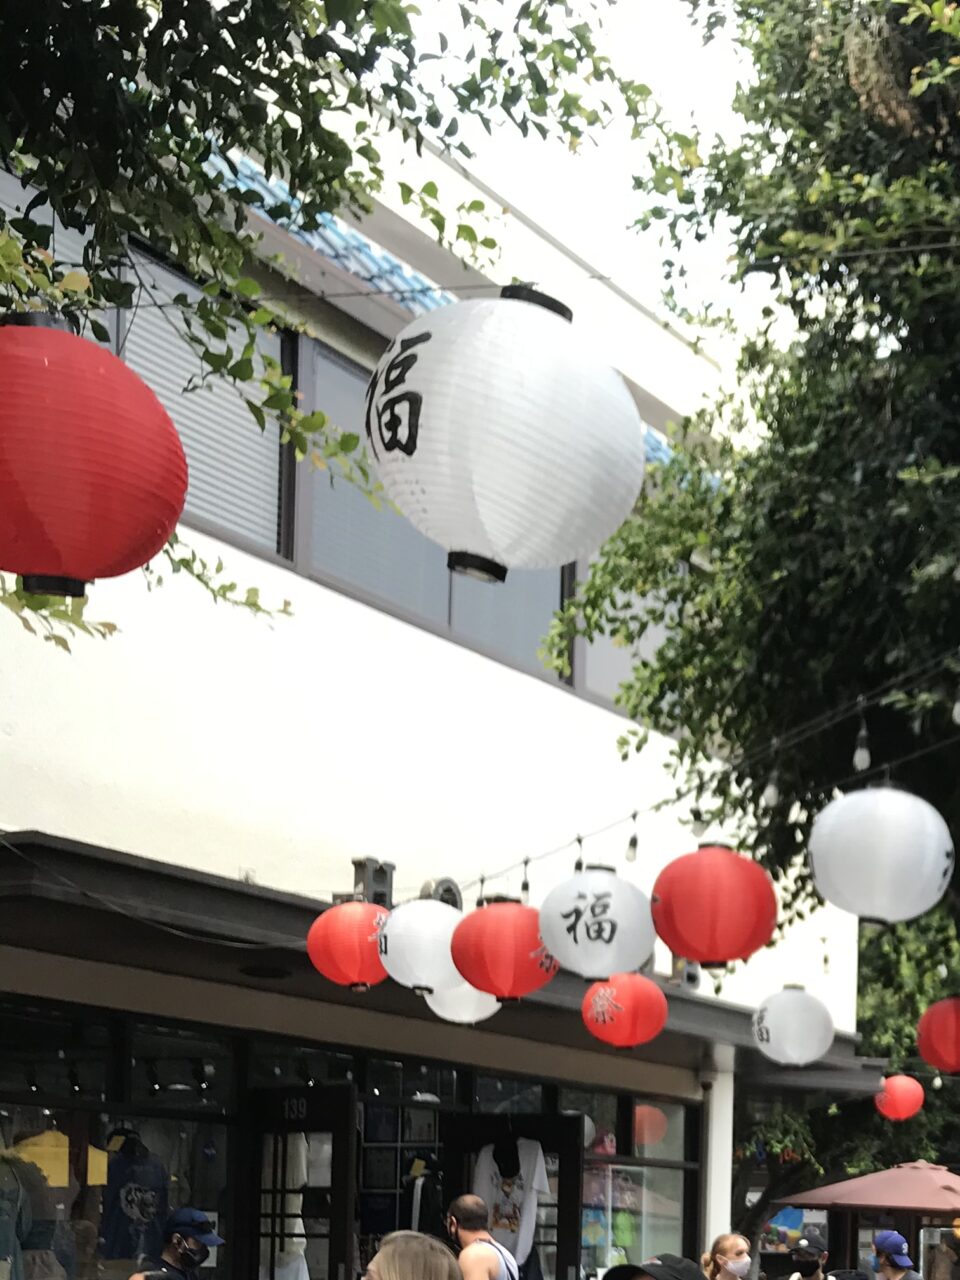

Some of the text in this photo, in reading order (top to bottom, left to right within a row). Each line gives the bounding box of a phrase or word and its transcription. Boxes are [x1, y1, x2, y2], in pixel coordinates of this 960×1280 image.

[560, 891, 618, 945] 福
[588, 986, 624, 1025] 祭
[282, 1097, 306, 1120] 139
